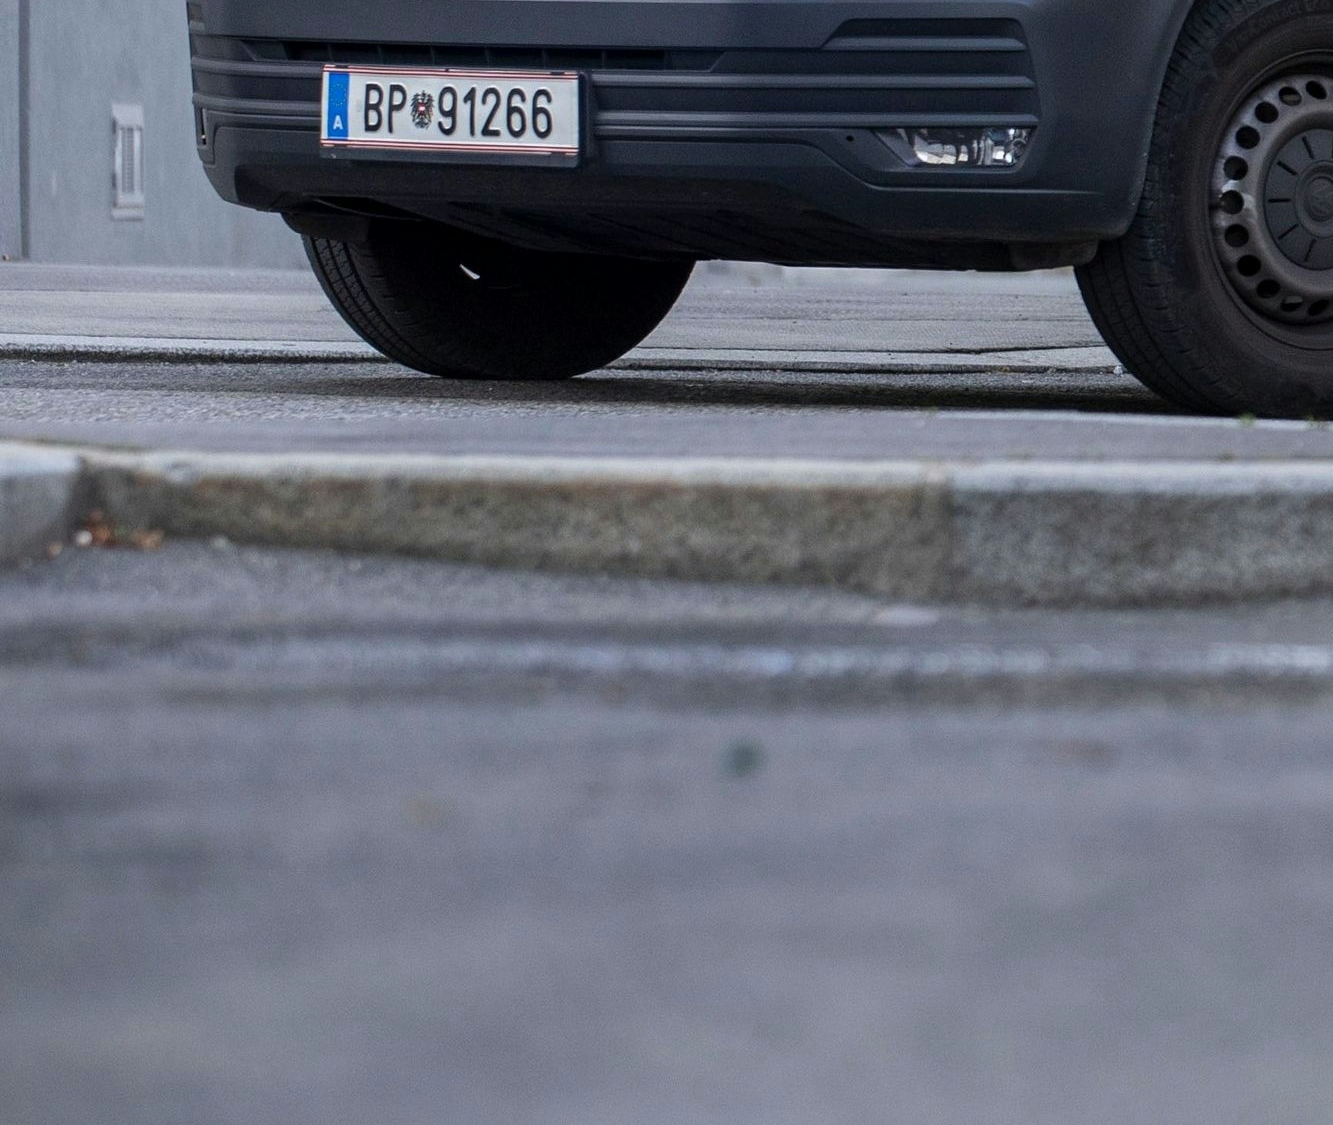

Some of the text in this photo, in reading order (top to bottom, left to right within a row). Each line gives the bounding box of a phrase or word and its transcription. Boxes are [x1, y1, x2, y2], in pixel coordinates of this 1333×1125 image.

[333, 83, 552, 139] A BP 91266
